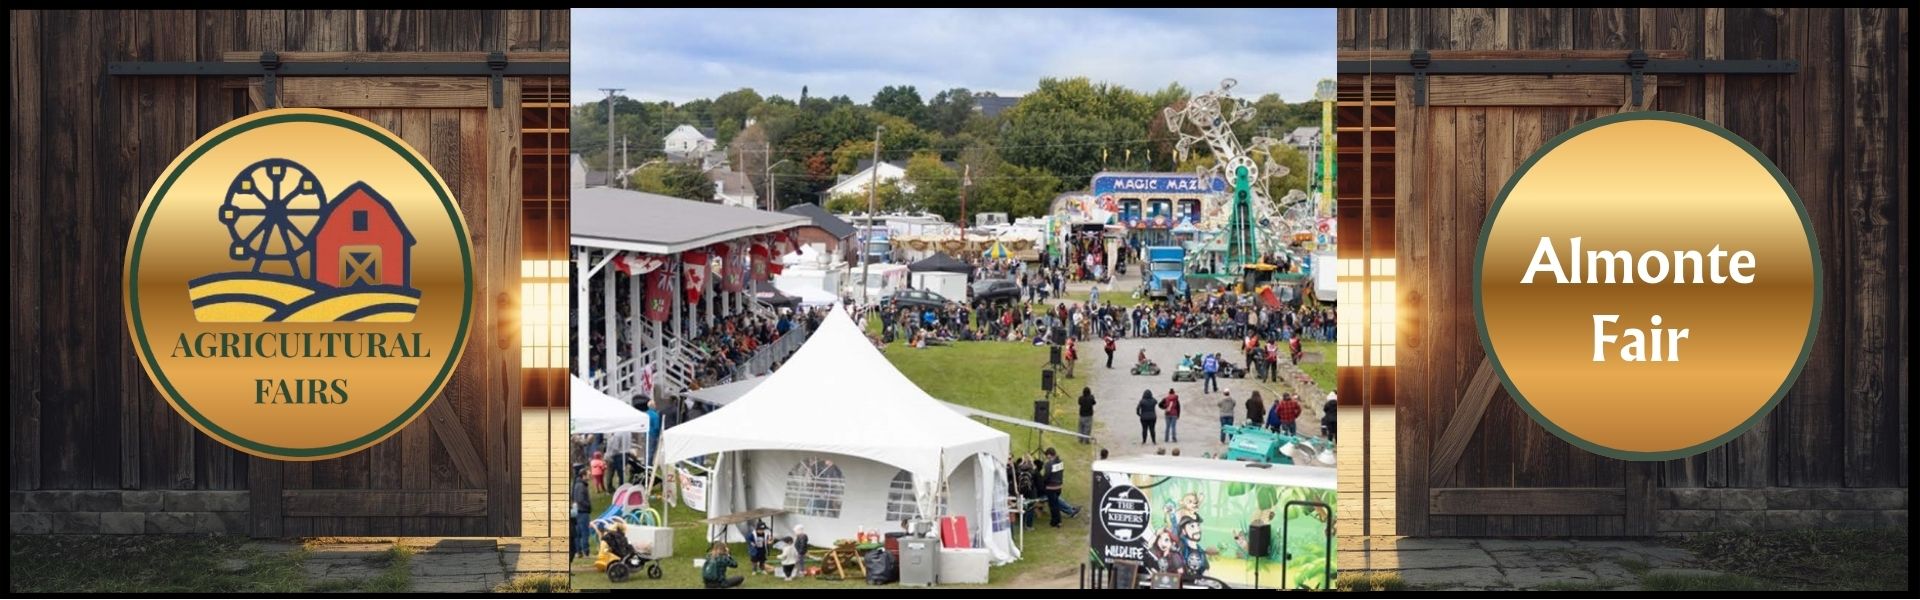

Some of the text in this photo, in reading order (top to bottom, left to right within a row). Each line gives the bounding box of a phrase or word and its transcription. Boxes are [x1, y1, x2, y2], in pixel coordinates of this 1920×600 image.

[1113, 179, 1204, 190] MAGIC MAZ
[1118, 501, 1134, 510] THE
[1108, 513, 1143, 523] KEEPERS
[1105, 545, 1143, 559] WILDLIFE
